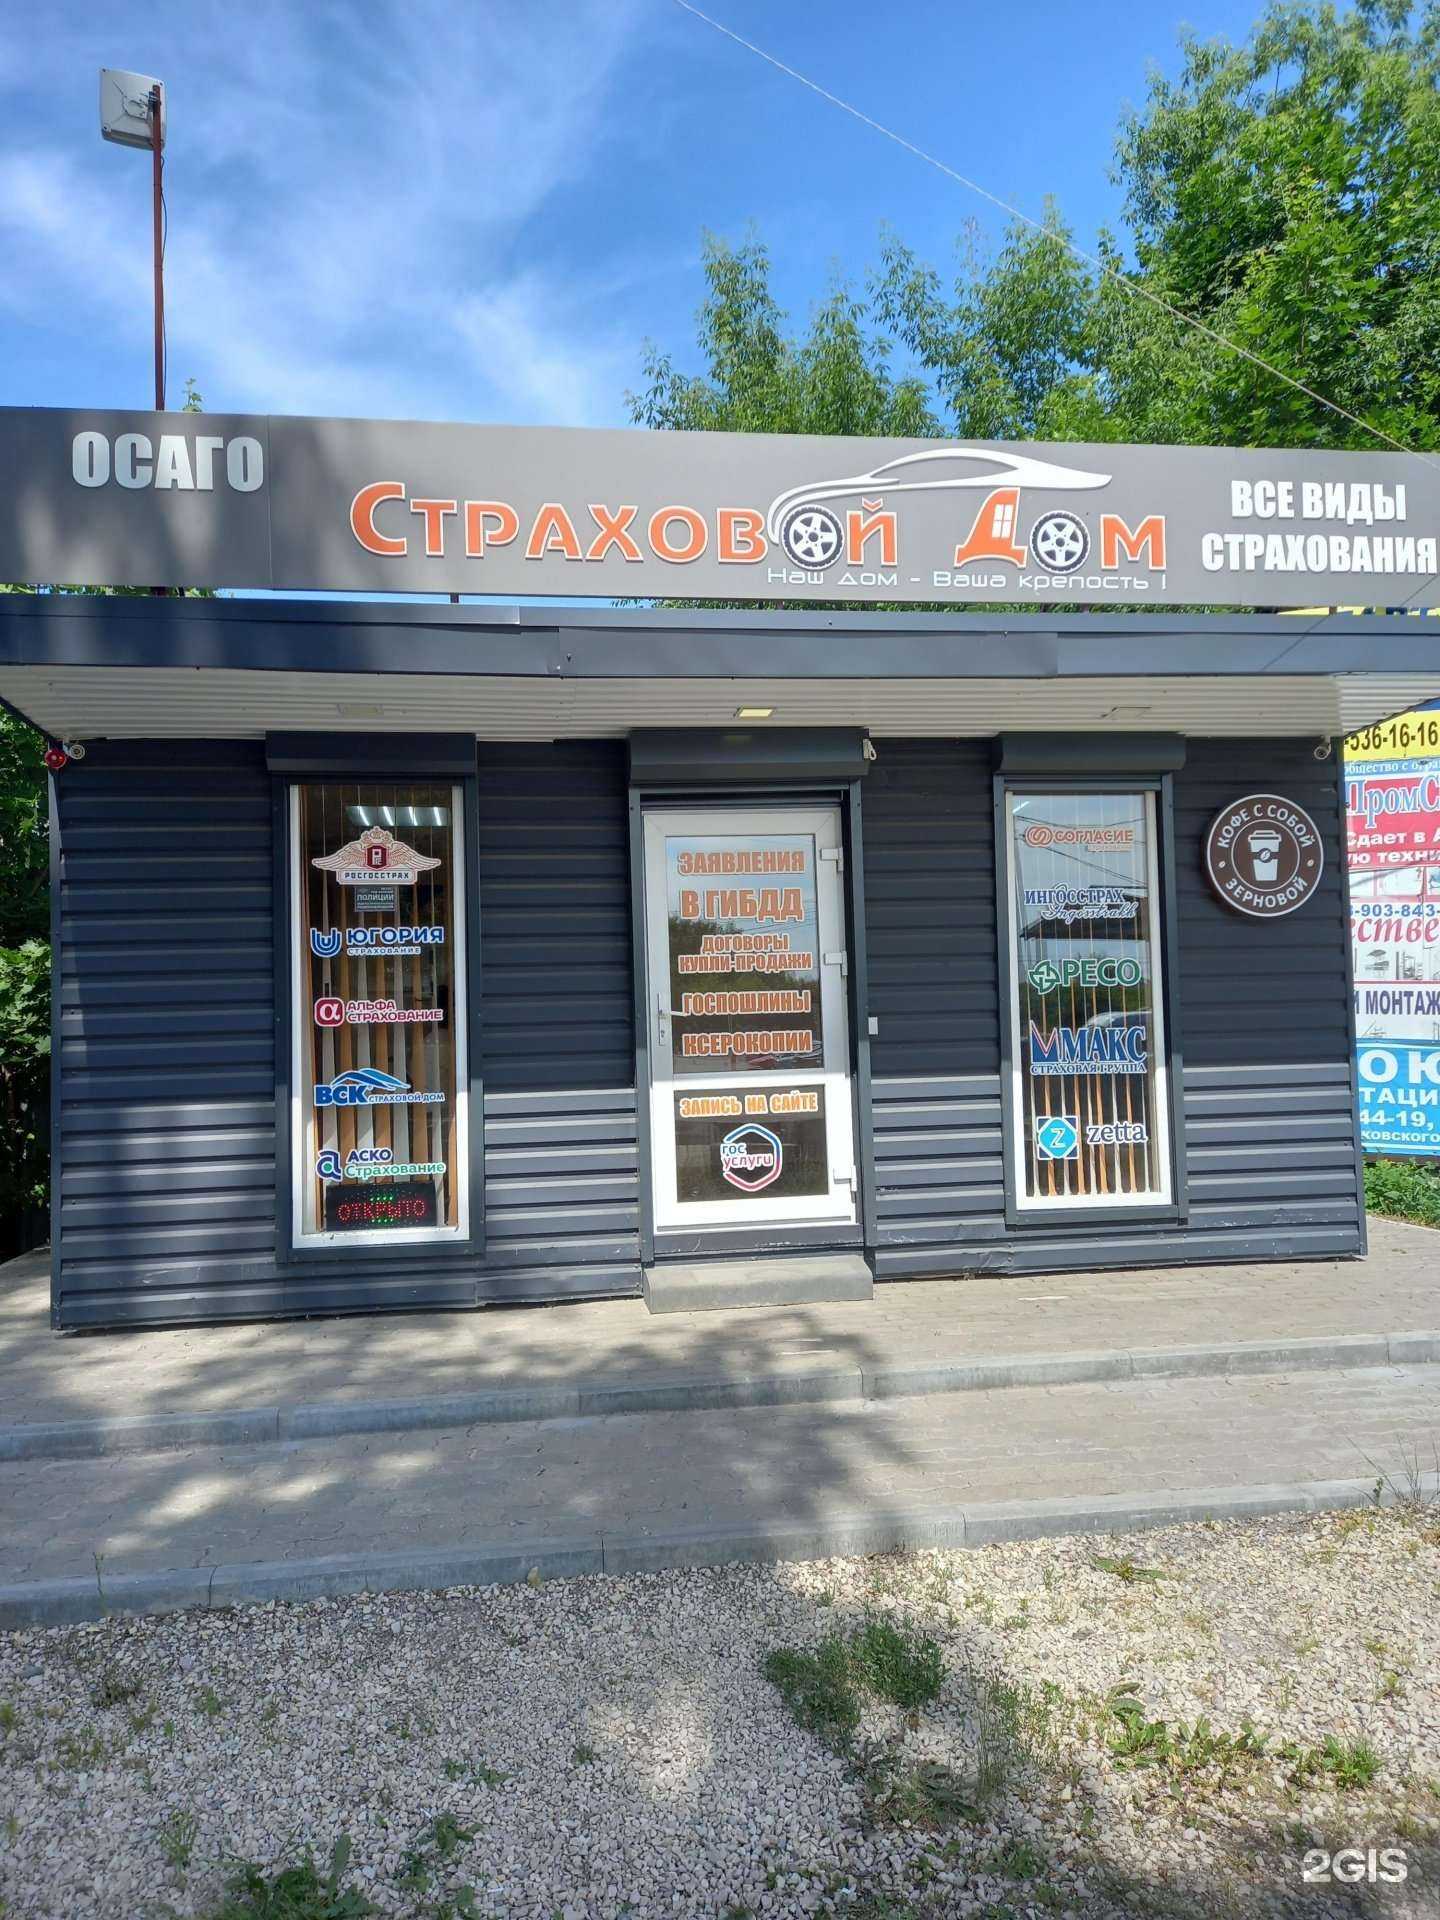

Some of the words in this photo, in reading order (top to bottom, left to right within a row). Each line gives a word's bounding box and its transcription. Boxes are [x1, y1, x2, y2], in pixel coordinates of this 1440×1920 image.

[72, 431, 264, 492] ОСАГО
[1231, 480, 1294, 519] ВСЕ
[1303, 482, 1407, 526] ВИДЫ
[1201, 533, 1438, 575] СТРАХОВАНИЯ
[933, 571, 1006, 588] Ваша
[1019, 574, 1149, 591] крепость
[1055, 829, 1133, 842] СОГЛАСИЕ
[1217, 808, 1251, 848] КОФЕ
[1267, 804, 1316, 848] СОБОЙ
[679, 851, 804, 875] ЗАЯВЛЕНИЯ
[344, 872, 410, 880] РОСГОССТРАХ
[1025, 883, 1124, 905] ИНГОССТРАХ
[1225, 876, 1308, 908] ЗЕРНОВОЙ
[681, 889, 700, 919] В
[704, 888, 803, 922] ГИБДД
[347, 927, 444, 944] ЮГОРИЯ
[702, 934, 789, 954] ДОГОВОРЫ
[347, 946, 421, 955] СТРАХОВАНИЕ
[679, 952, 813, 974] КУПЛИ-ПРОДАЖИ
[1061, 958, 1142, 987] РЕСО
[347, 1001, 395, 1011] АЛЬФА
[683, 990, 811, 1015] ГОСПОШЛИНЫ
[347, 1010, 443, 1021] СТРАХОВАНИЕ
[683, 1031, 812, 1057] КСЕРОКОПИИ
[1031, 1064, 1098, 1075] СТРАХОВАЯ
[1099, 1063, 1147, 1074] ГРУППА
[315, 1085, 368, 1106] ВСК
[369, 1093, 421, 1103] СТРАХОВОЙ
[422, 1093, 445, 1102] ДОМ
[680, 1096, 742, 1117] ЗАПИСЬ
[745, 1095, 768, 1114] НА
[770, 1091, 818, 1113] САЙТЕ
[1087, 1121, 1147, 1144] zetta
[347, 1148, 392, 1163] АСКО
[722, 1143, 747, 1155] гос
[346, 1163, 445, 1180] Страхование
[723, 1154, 773, 1170] услуги
